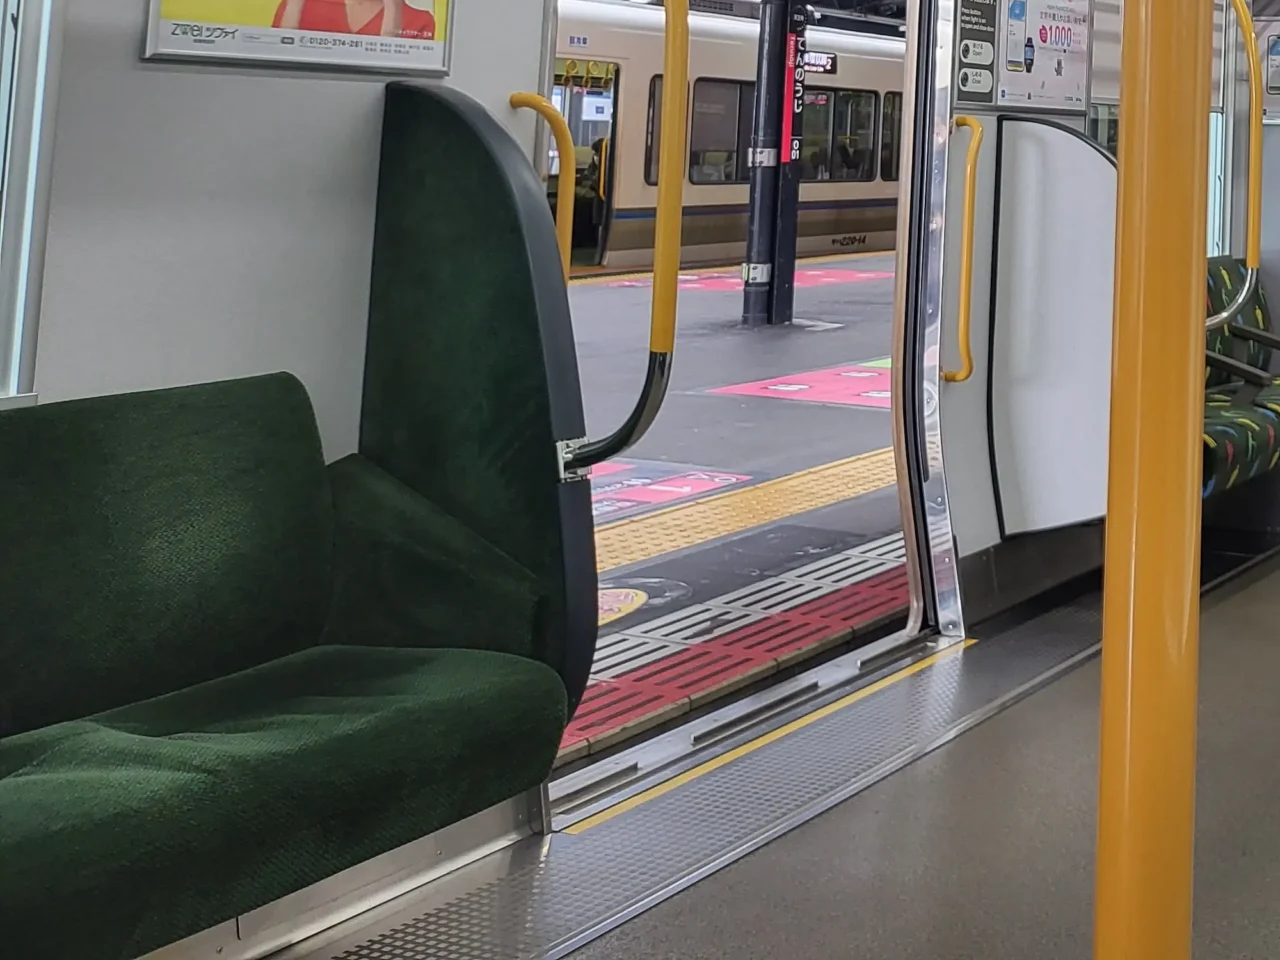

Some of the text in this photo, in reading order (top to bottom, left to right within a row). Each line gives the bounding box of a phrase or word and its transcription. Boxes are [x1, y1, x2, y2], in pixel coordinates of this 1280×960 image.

[794, 37, 806, 113] てんのうじ
